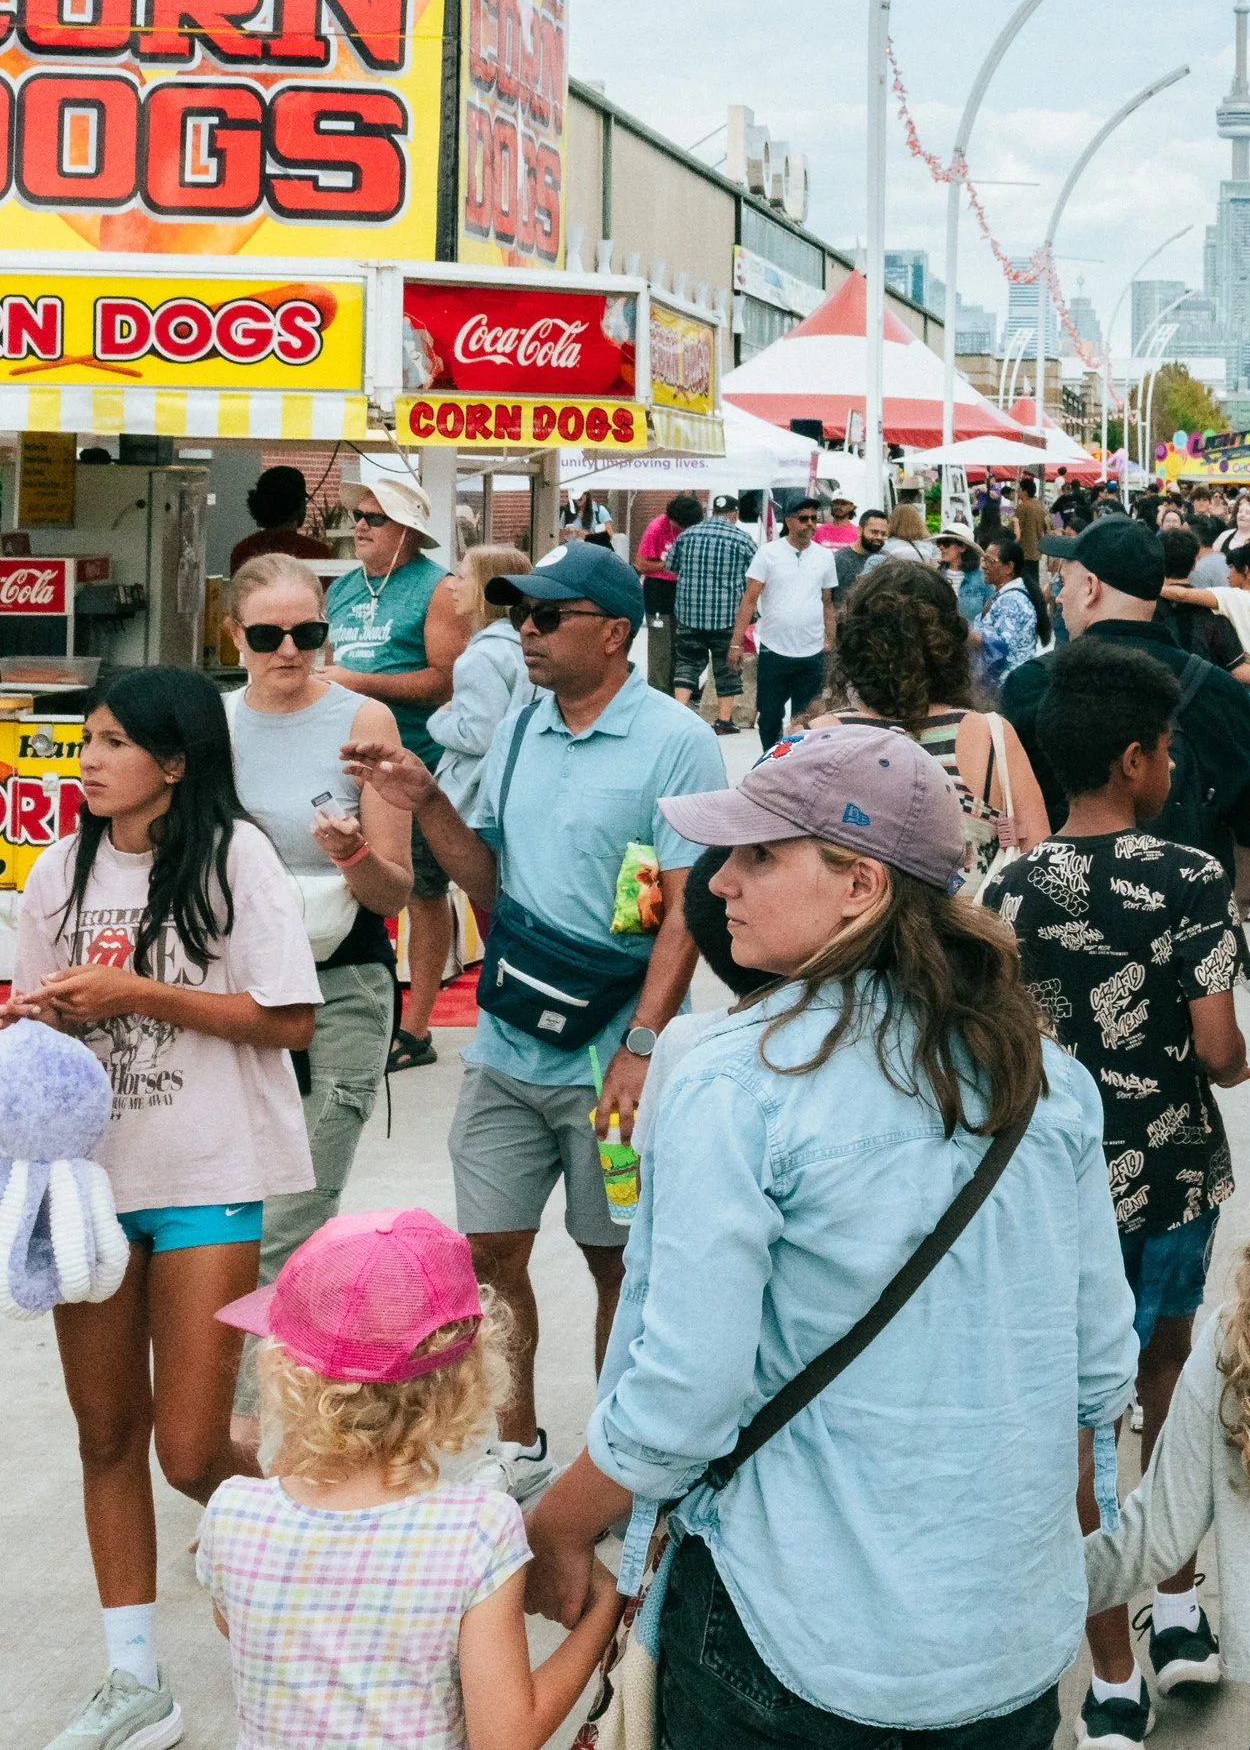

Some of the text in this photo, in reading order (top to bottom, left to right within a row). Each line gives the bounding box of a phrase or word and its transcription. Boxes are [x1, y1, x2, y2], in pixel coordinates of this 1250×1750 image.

[0, 75, 410, 220] OGS
[95, 296, 323, 364] DOGS
[454, 313, 589, 370] Coca-Cola
[408, 401, 636, 443] CORN DOGS
[675, 457, 709, 469] lives.
